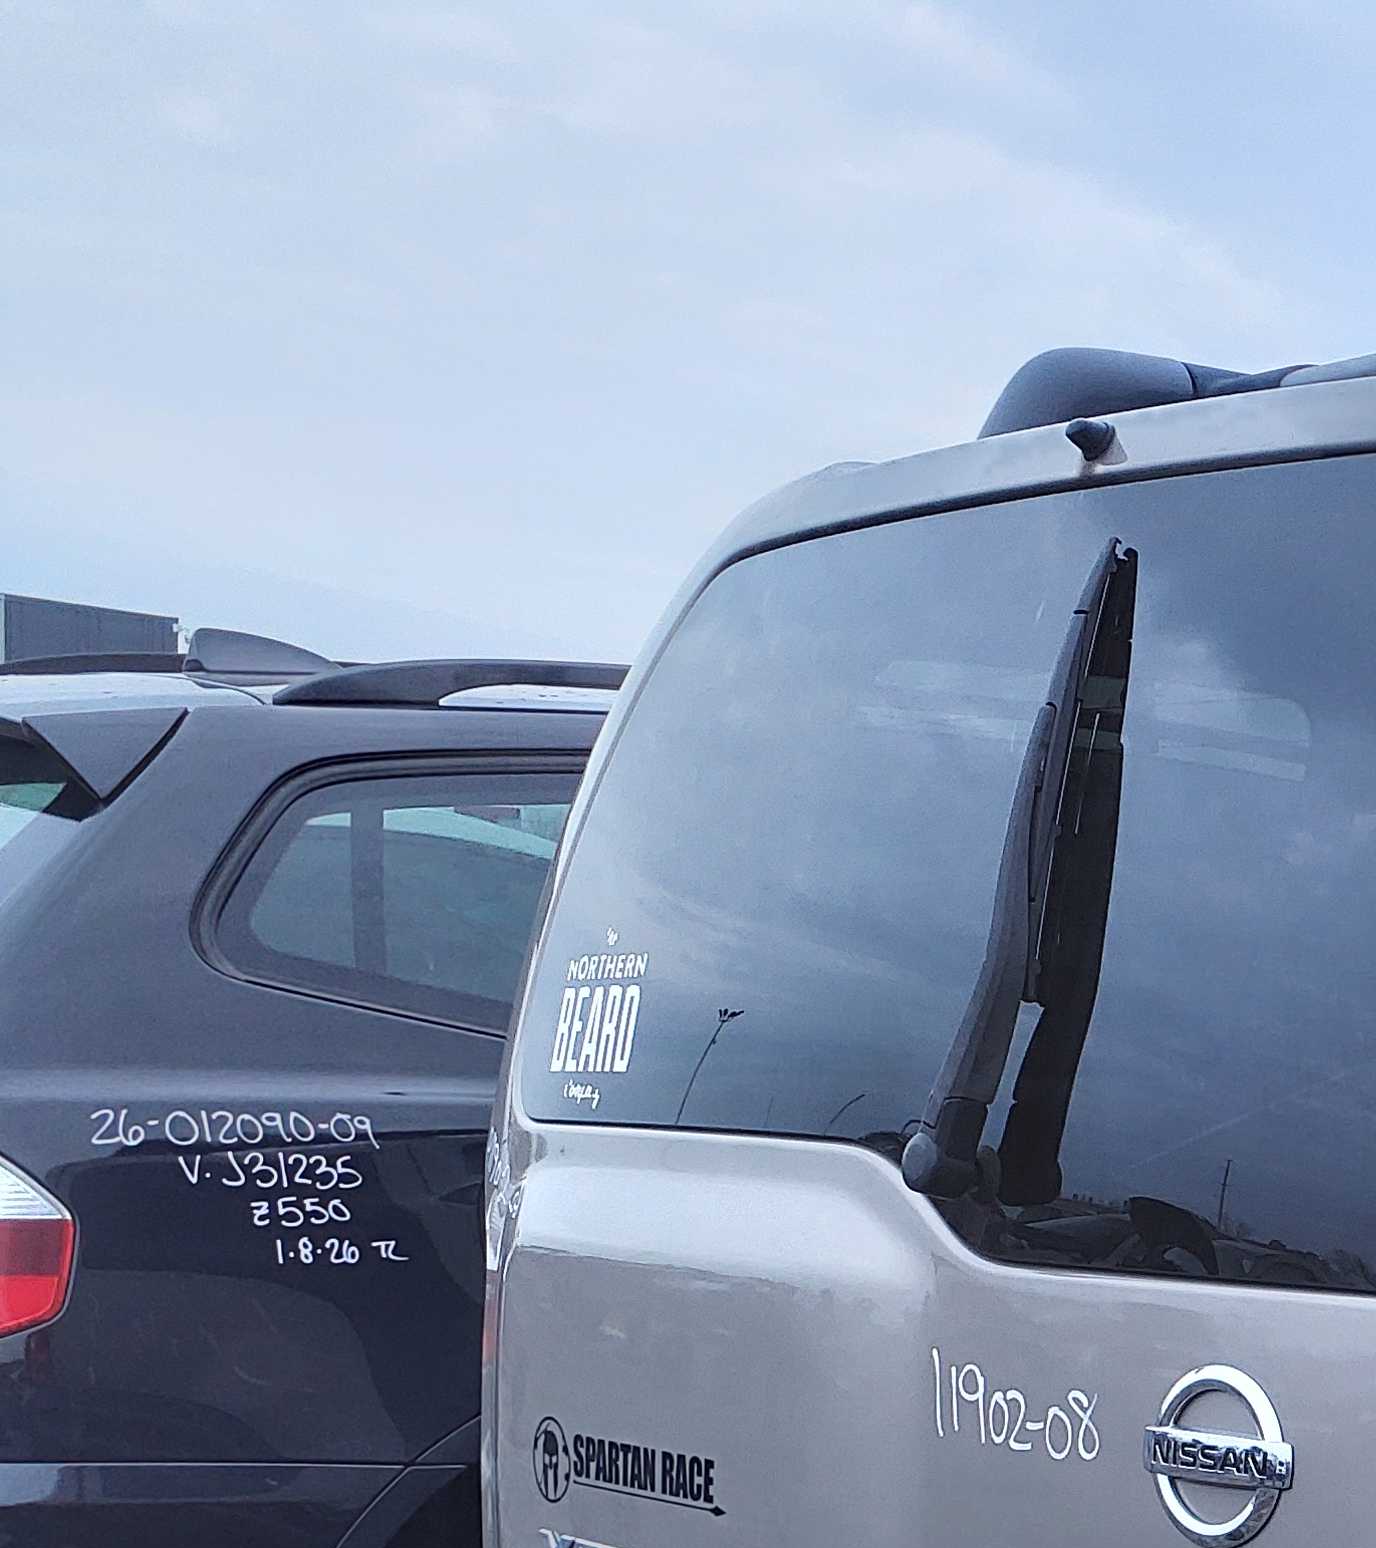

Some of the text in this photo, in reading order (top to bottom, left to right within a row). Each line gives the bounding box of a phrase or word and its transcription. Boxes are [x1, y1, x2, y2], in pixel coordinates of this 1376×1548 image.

[567, 952, 648, 981] NORTHERN
[549, 983, 642, 1073] BEARD
[90, 1108, 381, 1149] 26-012090-09
[931, 1346, 1101, 1462] 11902-08
[573, 1434, 716, 1505] SPARTAN RACE
[1151, 1438, 1268, 1480] NISSAN
